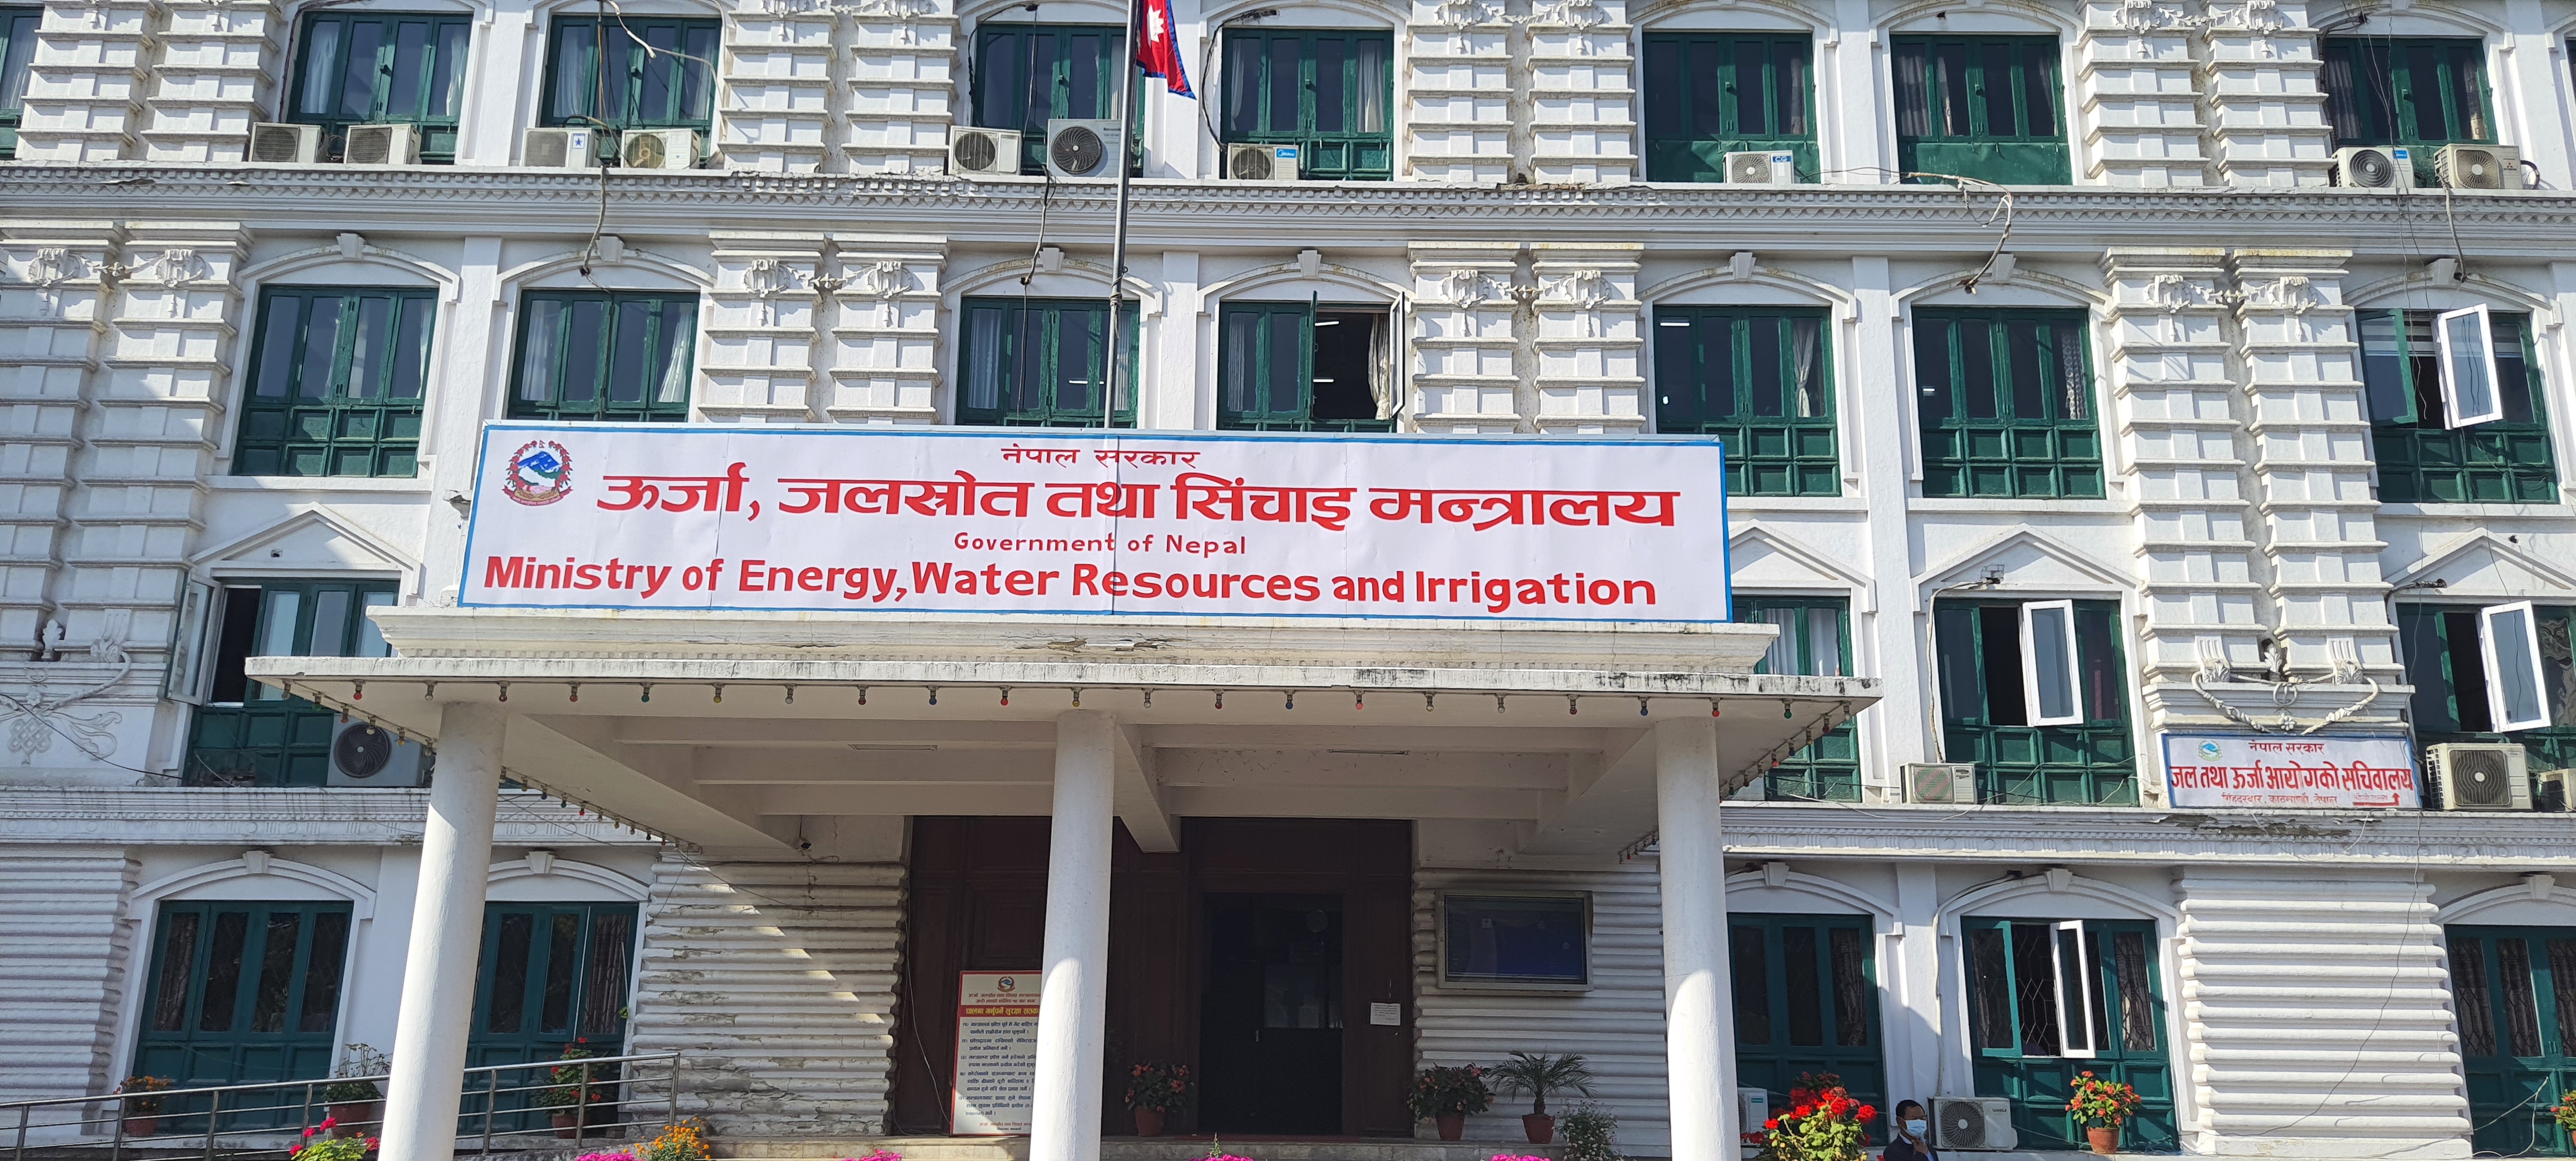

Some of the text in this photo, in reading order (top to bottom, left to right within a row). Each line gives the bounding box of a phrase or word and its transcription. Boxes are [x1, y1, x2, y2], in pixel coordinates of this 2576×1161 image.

[1001, 443, 1200, 469] नेपाल सरकार
[597, 462, 1680, 532] ऊर्जा, जलस्रोत तथा सिंचाइ मन्त्रालय
[955, 532, 1246, 558] Government of Nepal
[484, 556, 671, 599] Ministry
[682, 558, 724, 591] of
[1072, 563, 1320, 602] Resources
[1332, 571, 1404, 602] and
[1417, 571, 1656, 613] Irrigation
[2248, 740, 2325, 755] नेपाल सरकार
[2169, 759, 2413, 792] जल तथा ऊर्जा आयोगको सचिवालय
